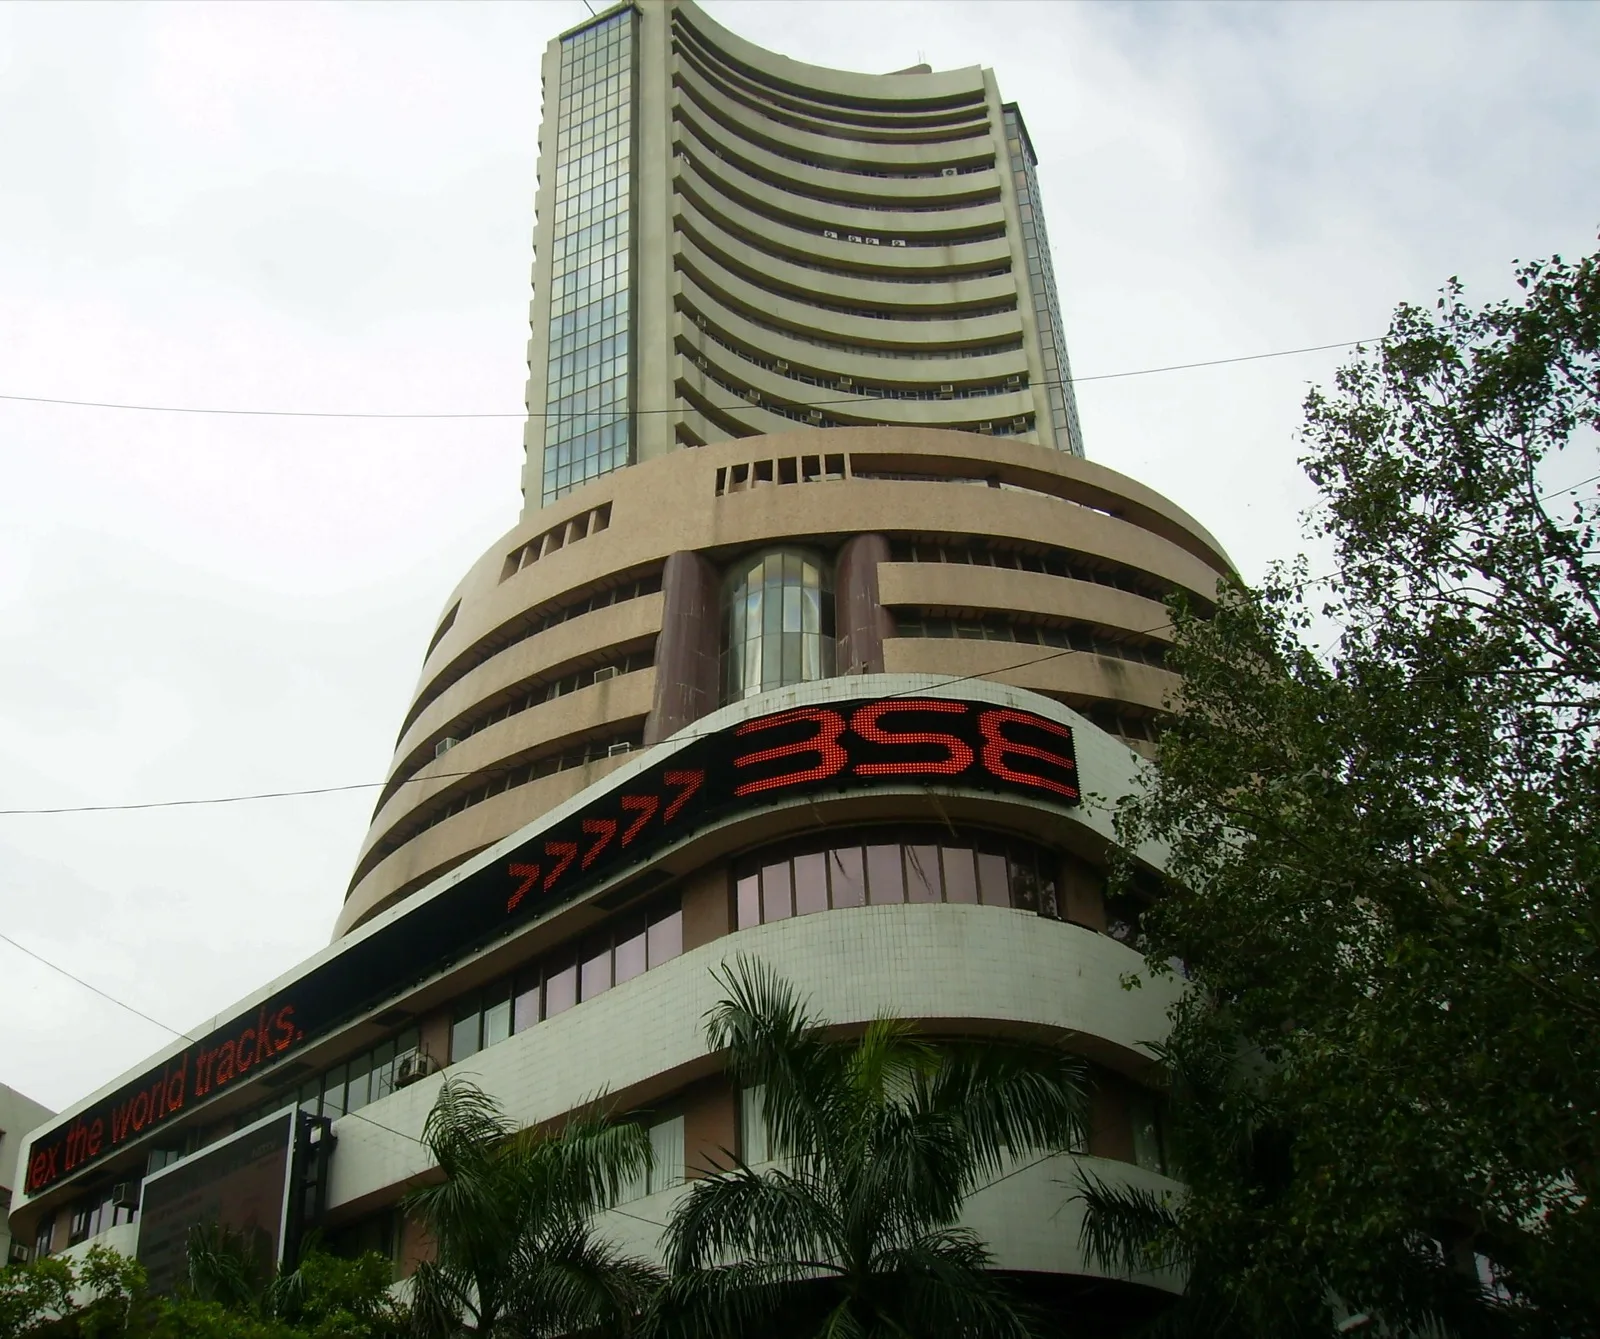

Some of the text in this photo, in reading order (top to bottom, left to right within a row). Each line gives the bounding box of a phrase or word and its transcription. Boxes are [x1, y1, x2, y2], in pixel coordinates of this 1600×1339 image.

[65, 1117, 104, 1171] the
[111, 1052, 189, 1144] world
[195, 1004, 304, 1097] tracks.
